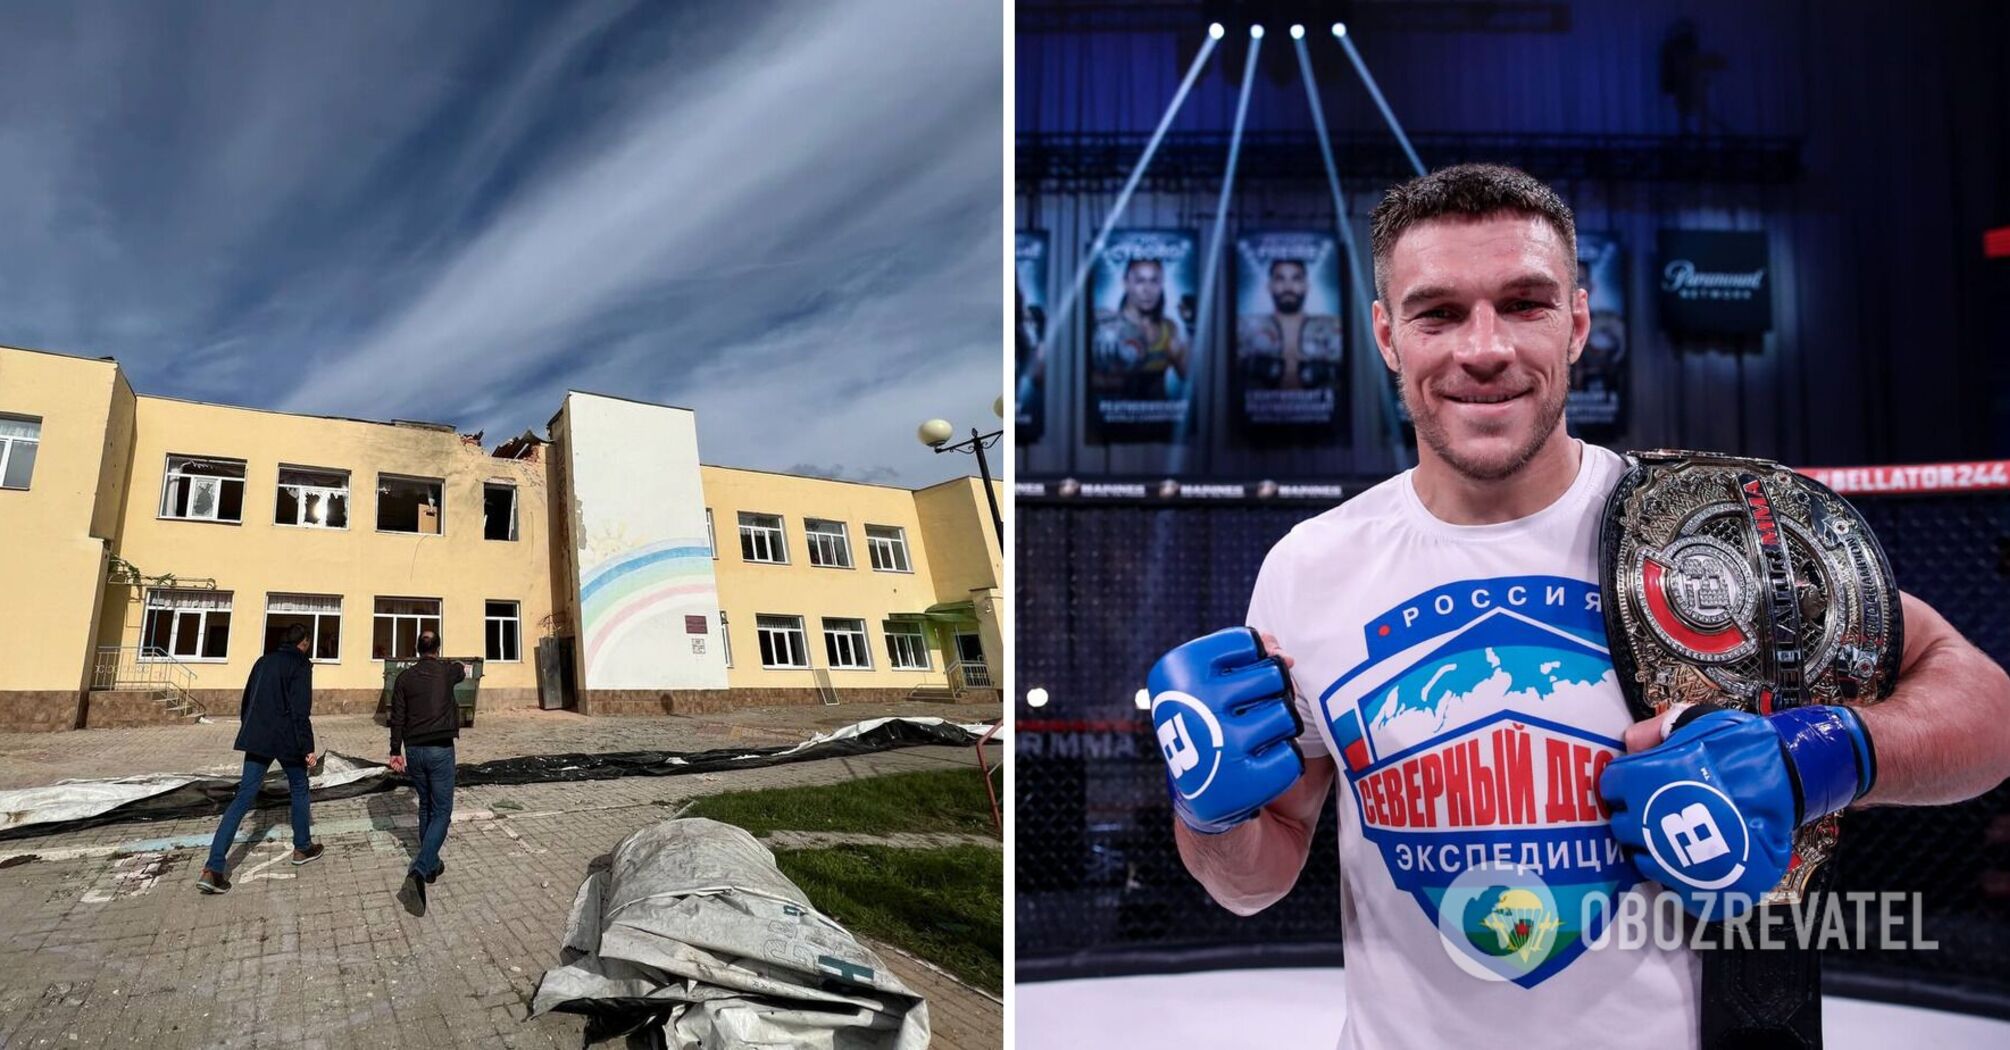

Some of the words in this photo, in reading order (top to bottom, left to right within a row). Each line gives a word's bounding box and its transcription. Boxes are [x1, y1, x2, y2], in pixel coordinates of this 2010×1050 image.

[1662, 260, 1764, 290] Paramount
[1743, 479, 1780, 545] MMA
[1403, 586, 1602, 628] РОССИЯ
[1359, 722, 1537, 828] СЕВЕРНЫЙ
